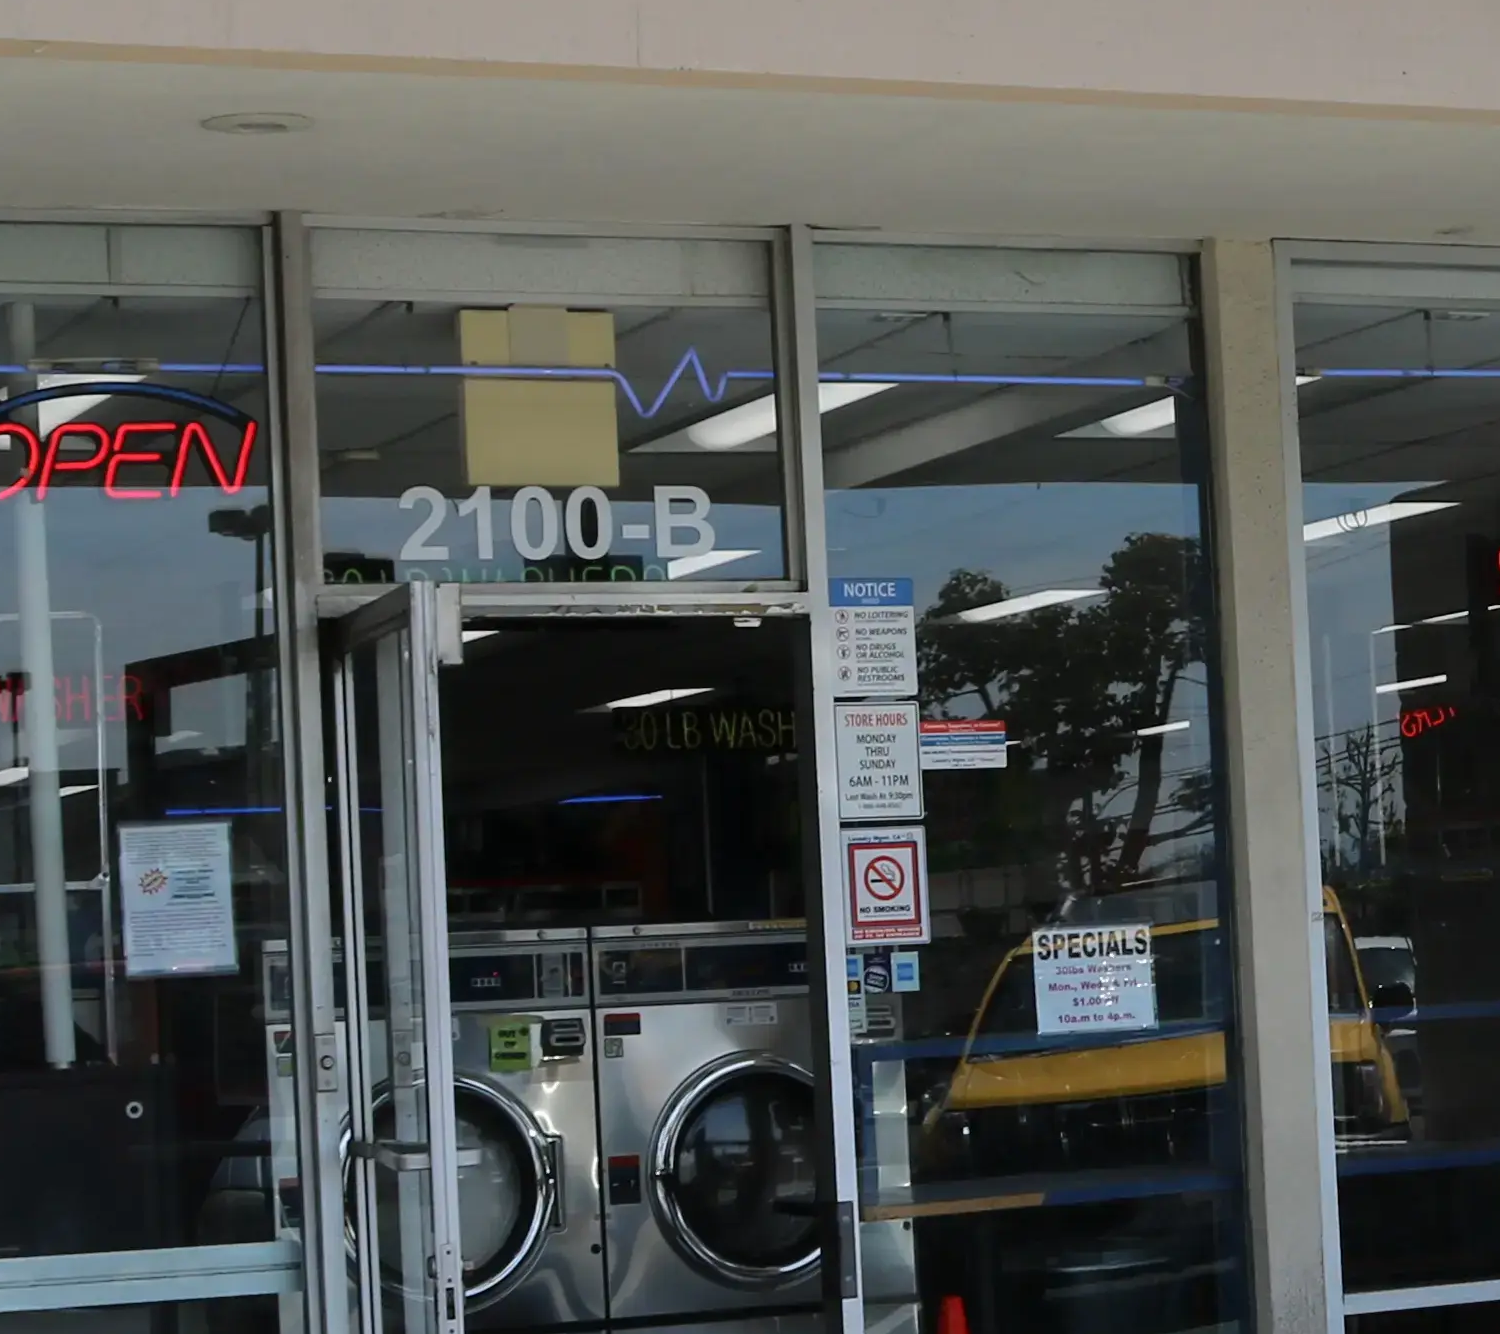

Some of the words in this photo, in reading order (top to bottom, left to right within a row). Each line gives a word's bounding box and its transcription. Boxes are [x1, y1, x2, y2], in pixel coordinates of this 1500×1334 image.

[398, 484, 717, 561] 2100-B
[843, 582, 897, 597] NOTICE
[854, 611, 867, 619] NO
[855, 628, 867, 636] NO
[869, 627, 908, 636] WEAPONS
[855, 643, 868, 651] NO
[857, 666, 869, 674] NO
[844, 713, 873, 727] STORE
[876, 712, 908, 726] HOURS
[856, 733, 897, 744] MONDAY
[864, 746, 890, 757] THRU
[859, 759, 896, 770] SUNDAY
[849, 776, 872, 788] 6AM
[882, 775, 909, 787] 11PM
[859, 906, 871, 914] NO
[873, 905, 911, 913] SMOKING
[1037, 929, 1148, 960] SPECIALS
[1072, 996, 1101, 1007] $1.00
[1093, 1013, 1104, 1022] to
